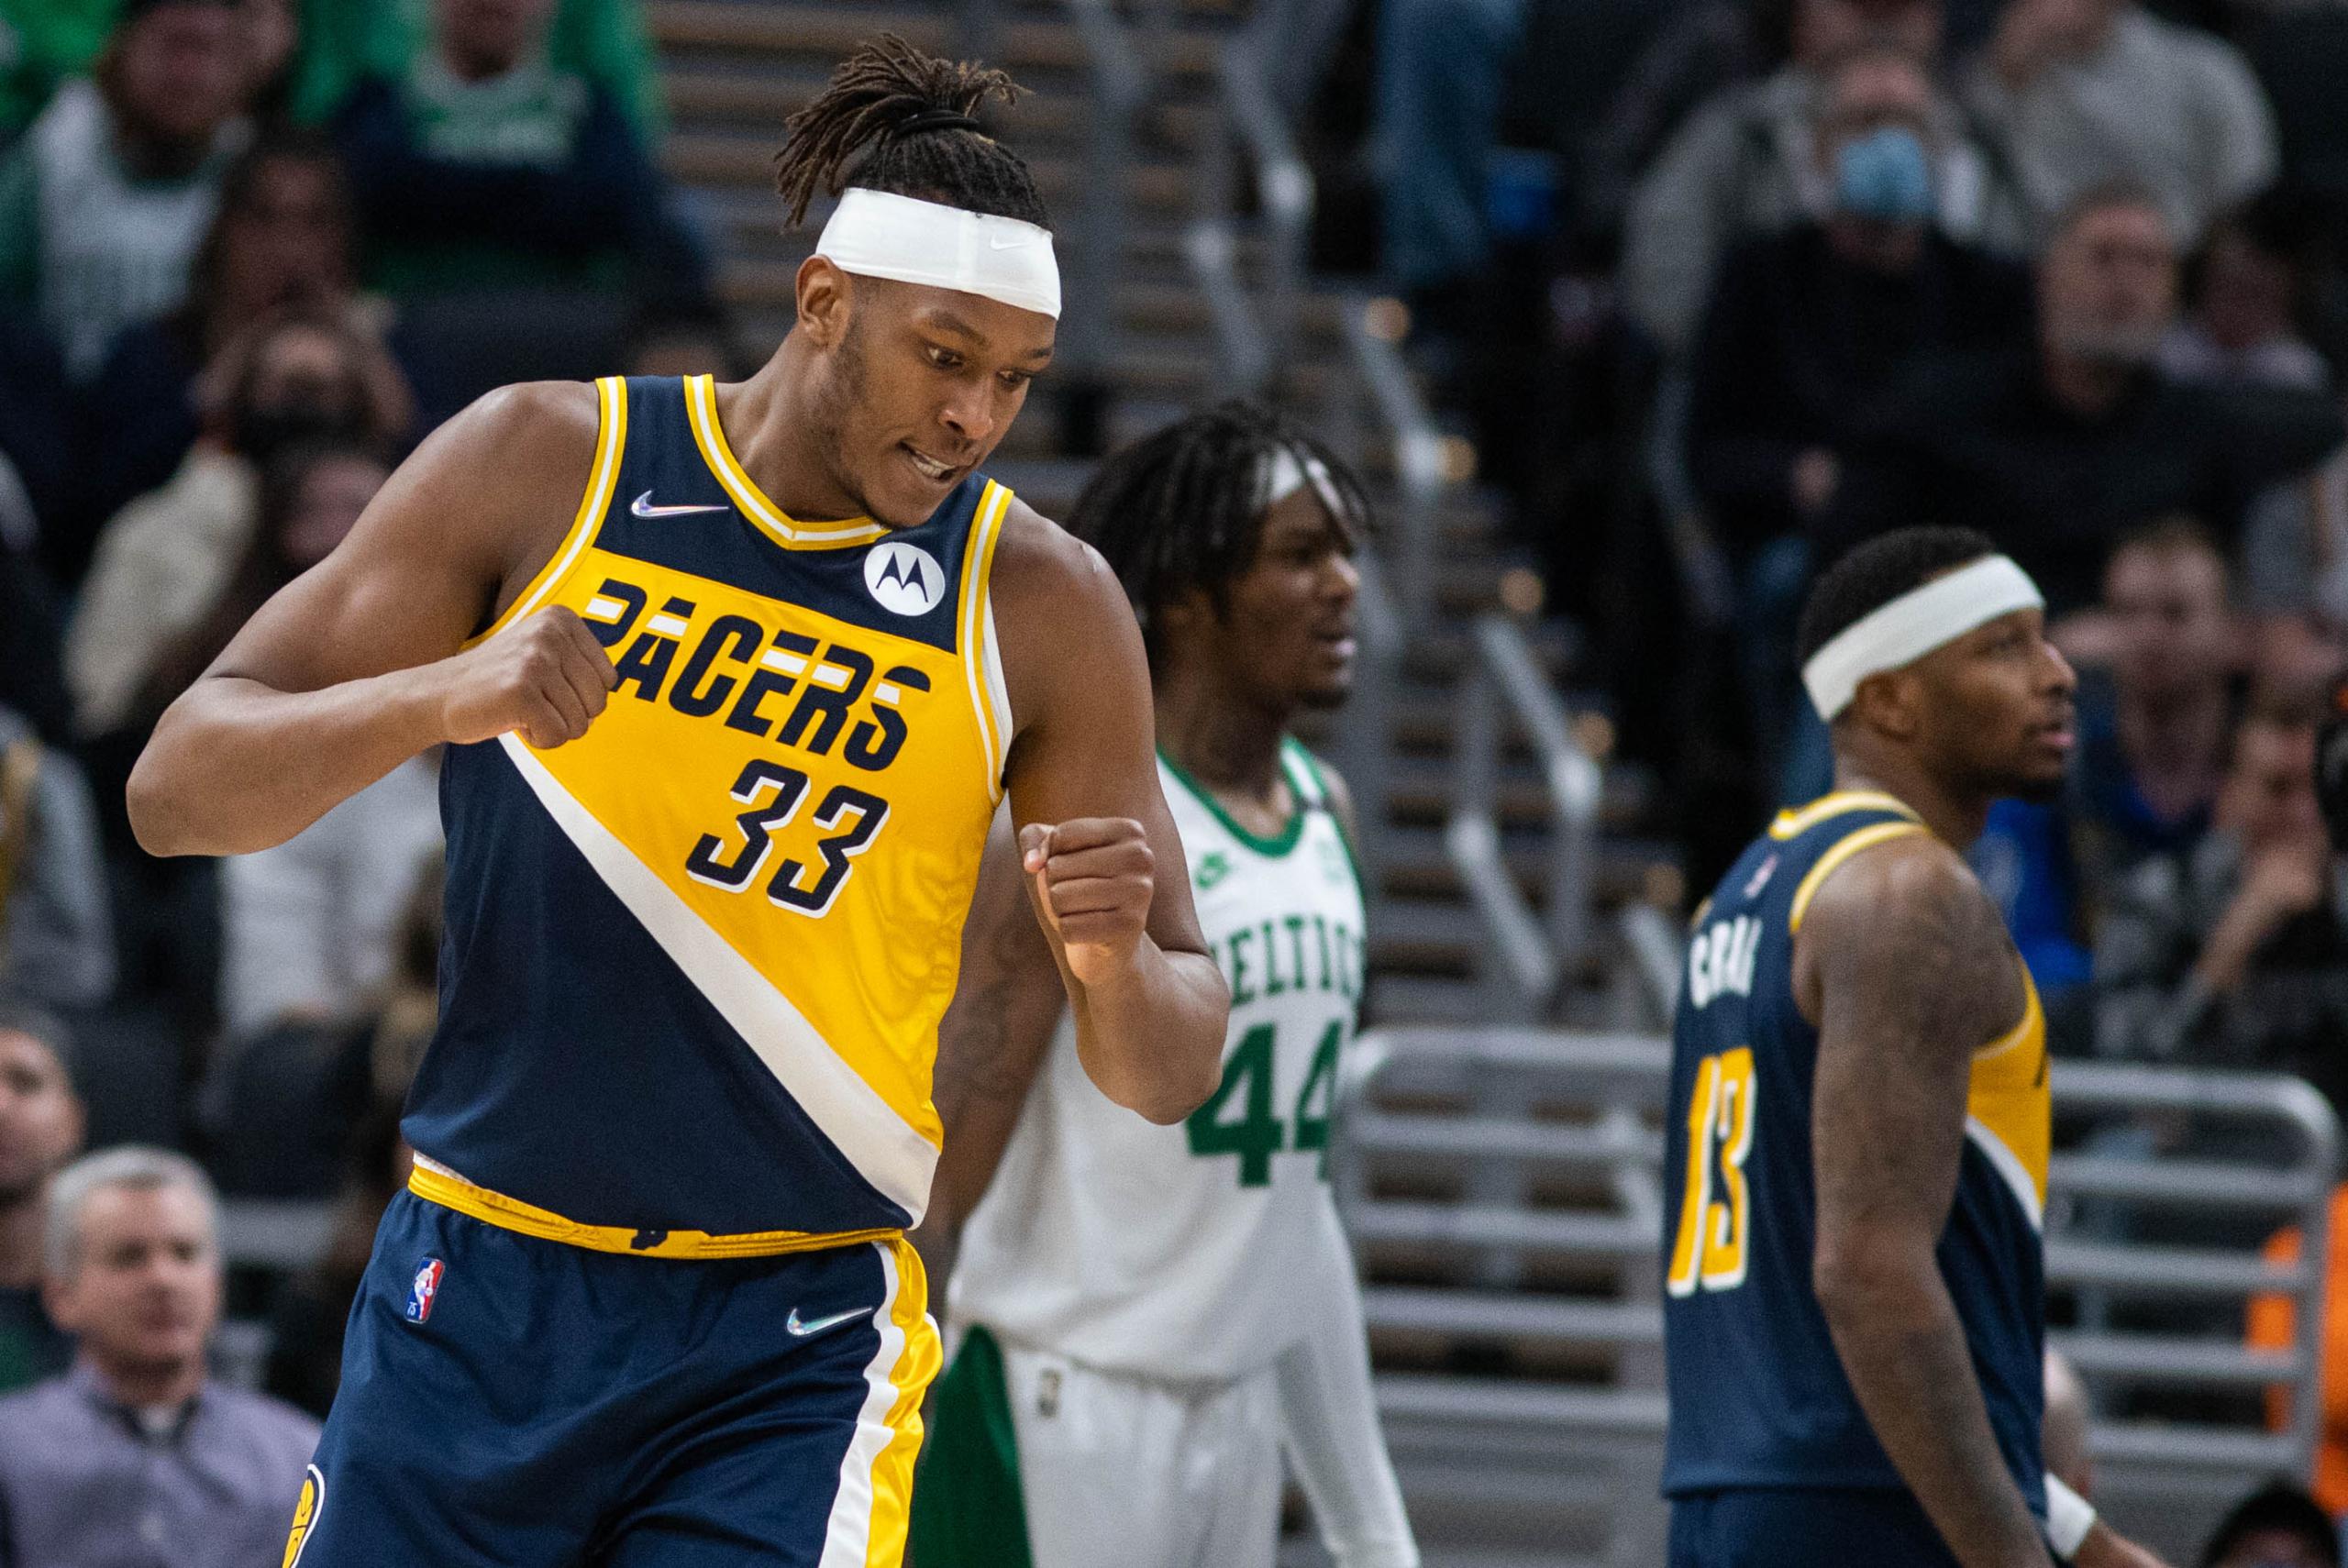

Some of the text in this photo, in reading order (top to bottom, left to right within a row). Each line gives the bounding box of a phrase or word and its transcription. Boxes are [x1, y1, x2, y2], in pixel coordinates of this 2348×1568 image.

[582, 578, 931, 771] PACERS
[686, 758, 891, 919] 33
[1186, 1021, 1341, 1187] 44
[1667, 1046, 1756, 1298] 13
[407, 1301, 418, 1316] 75
